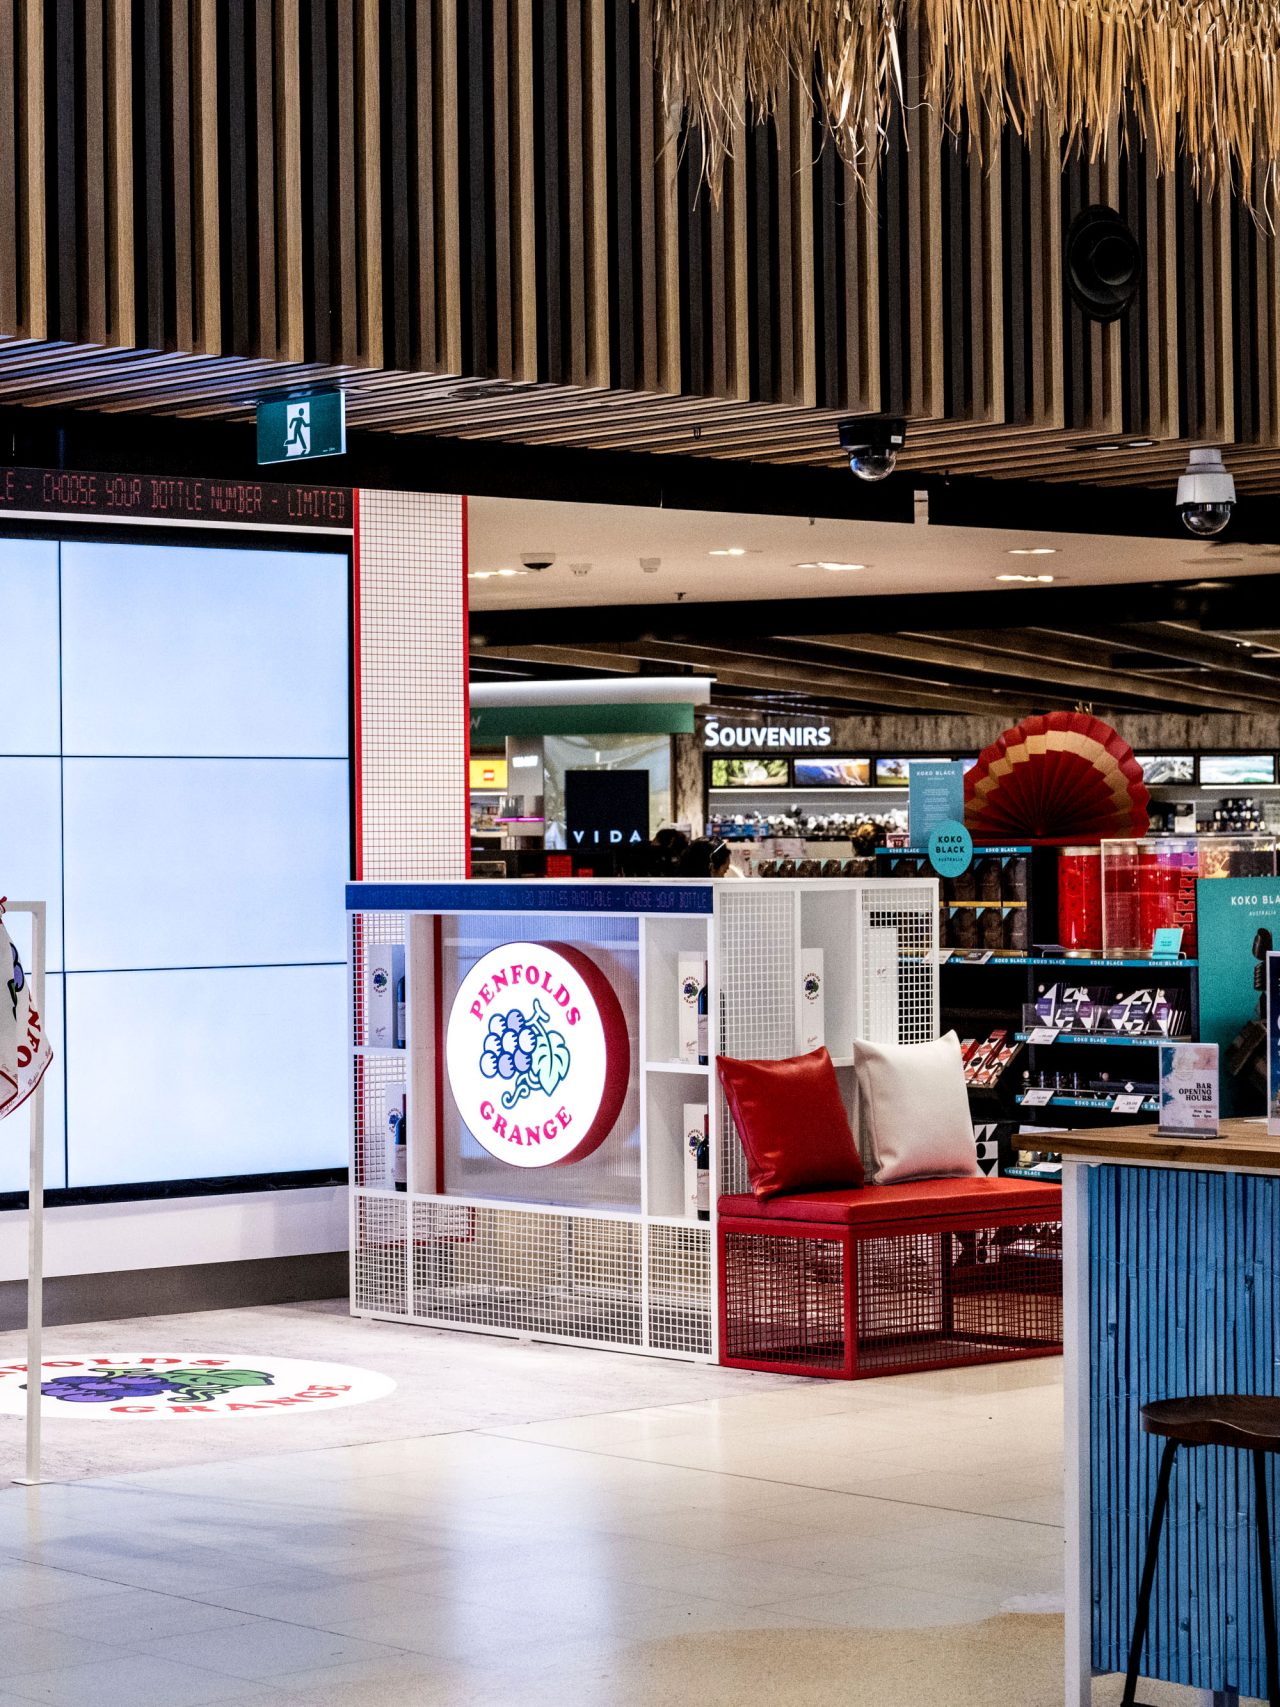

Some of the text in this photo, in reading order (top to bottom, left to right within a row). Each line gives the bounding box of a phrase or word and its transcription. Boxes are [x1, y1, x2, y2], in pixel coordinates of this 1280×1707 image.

[43, 473, 96, 505] CHOOSE
[105, 478, 141, 507] YOUR
[150, 480, 202, 511] BOTTLE
[210, 486, 262, 513] NUMBER
[287, 489, 345, 518] LIMITED
[704, 721, 831, 747] SOUVENIRS
[573, 830, 642, 843] VIDA
[935, 846, 965, 854] BLACK
[1231, 895, 1258, 906] KOKO
[470, 964, 581, 1026] PENFOLDS
[479, 1100, 573, 1146] GRANGE
[109, 1384, 353, 1414] GRANGE
